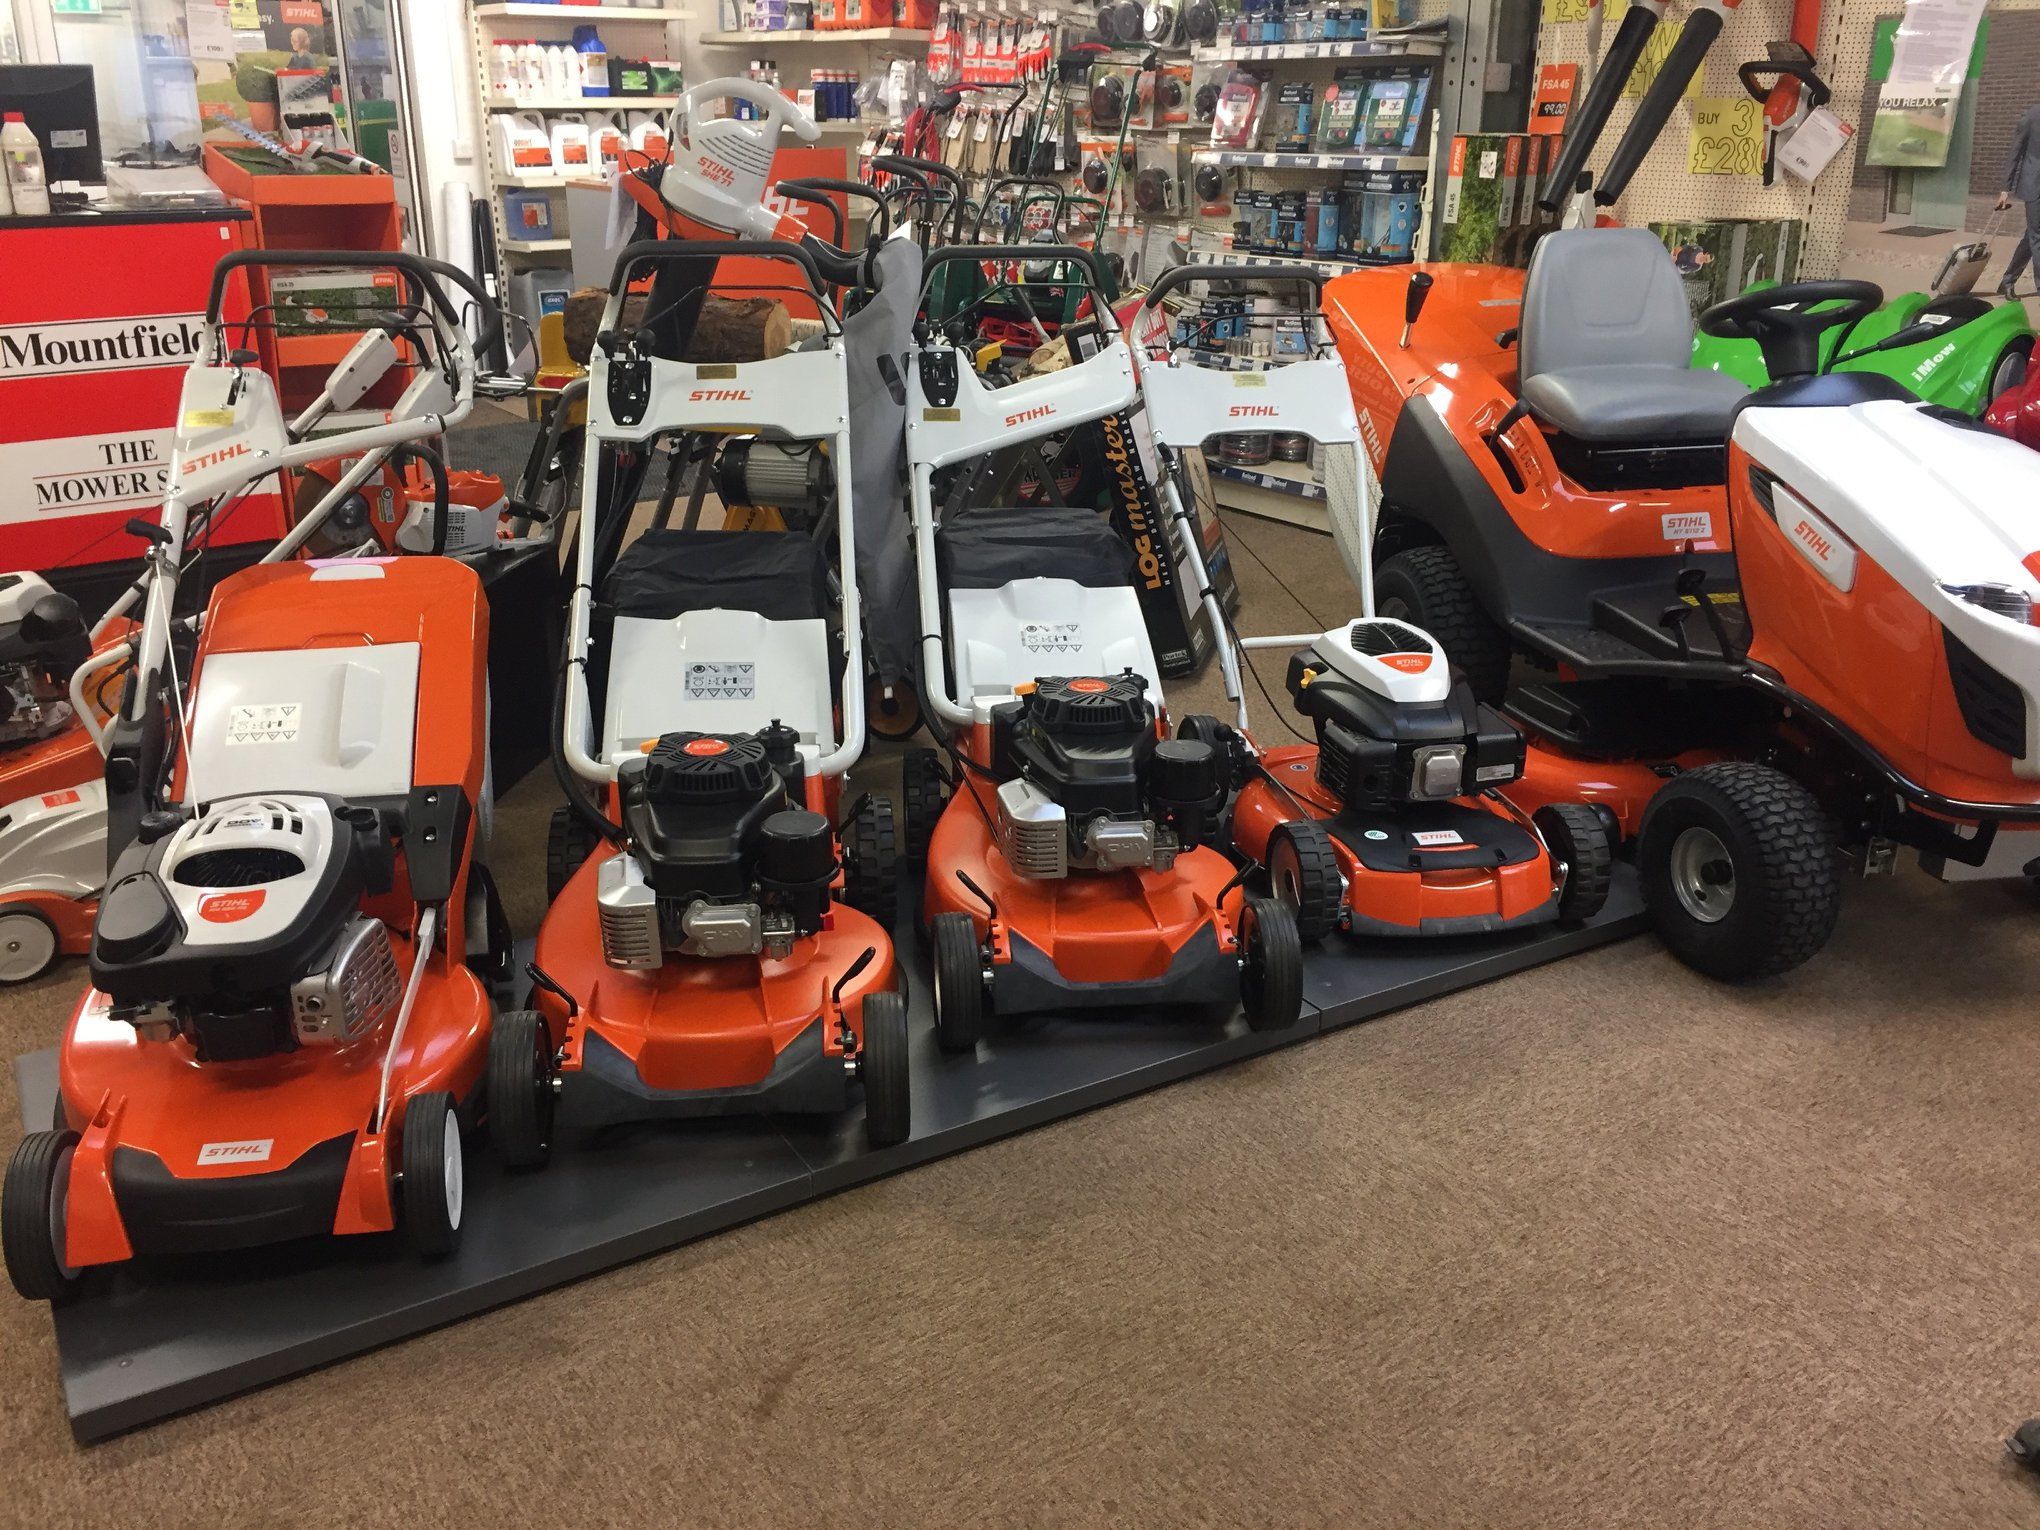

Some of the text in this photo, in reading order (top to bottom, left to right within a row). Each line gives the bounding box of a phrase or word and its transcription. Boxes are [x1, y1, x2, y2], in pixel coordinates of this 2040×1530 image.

[285, 7, 318, 18] STIHL
[1542, 79, 1560, 90] FSA
[1543, 103, 1567, 114] 99.00
[1879, 97, 1937, 107] YOU RELAX
[1697, 98, 1755, 138] BUY 3
[697, 156, 735, 181] STIHL
[1452, 142, 1463, 173] STIHL
[1508, 142, 1519, 173] STIHL
[1529, 141, 1539, 173] STIHL
[701, 169, 734, 187] SHE 71
[1447, 193, 1457, 219] FSA 45
[1910, 342, 1956, 382] iMow
[688, 390, 752, 402] STIHL
[1005, 404, 1057, 428] STIHL
[1228, 405, 1280, 417] STIHL
[1358, 407, 1386, 465] STIHL
[98, 439, 159, 466] THE
[181, 443, 252, 475] STIHL
[35, 471, 150, 505] MOWER
[1133, 464, 1146, 491] SAW
[1143, 500, 1158, 534] DUTY
[1667, 516, 1706, 528] STIHL
[1794, 519, 1835, 562] STIHL
[1134, 534, 1162, 590] LOG
[1154, 543, 1172, 586] HEAVY
[1396, 658, 1424, 667] STIHL
[209, 898, 250, 908] STIHL
[204, 1145, 263, 1158] STIHL
